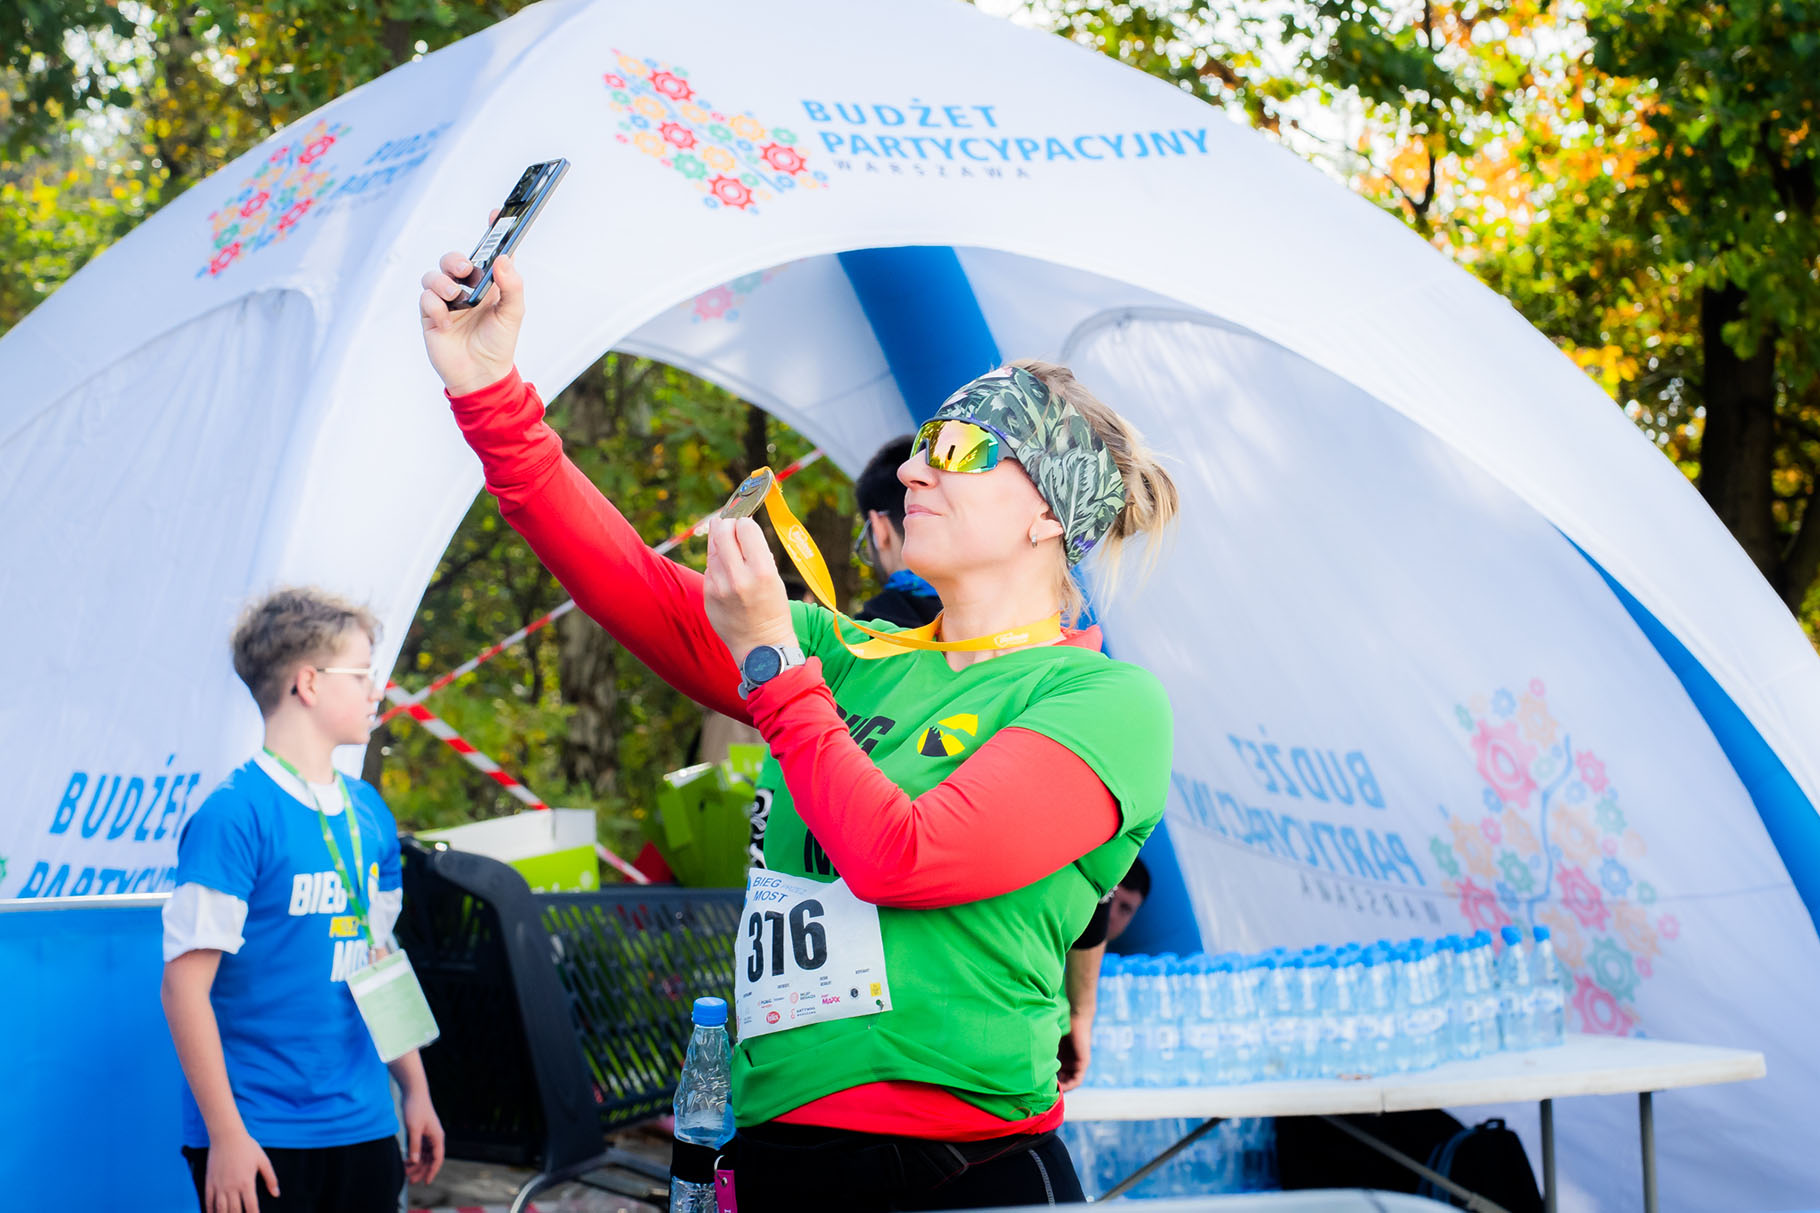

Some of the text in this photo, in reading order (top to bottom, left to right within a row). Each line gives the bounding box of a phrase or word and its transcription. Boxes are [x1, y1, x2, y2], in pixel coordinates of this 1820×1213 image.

[802, 98, 998, 129] BUDŻET
[818, 129, 1210, 162] PARTYCYPACYJNY
[833, 158, 1031, 179] WARSZAWA
[49, 754, 200, 842] BUDŻET
[752, 876, 782, 889] BIEG
[753, 890, 788, 903] MOST
[747, 898, 828, 984] 376
